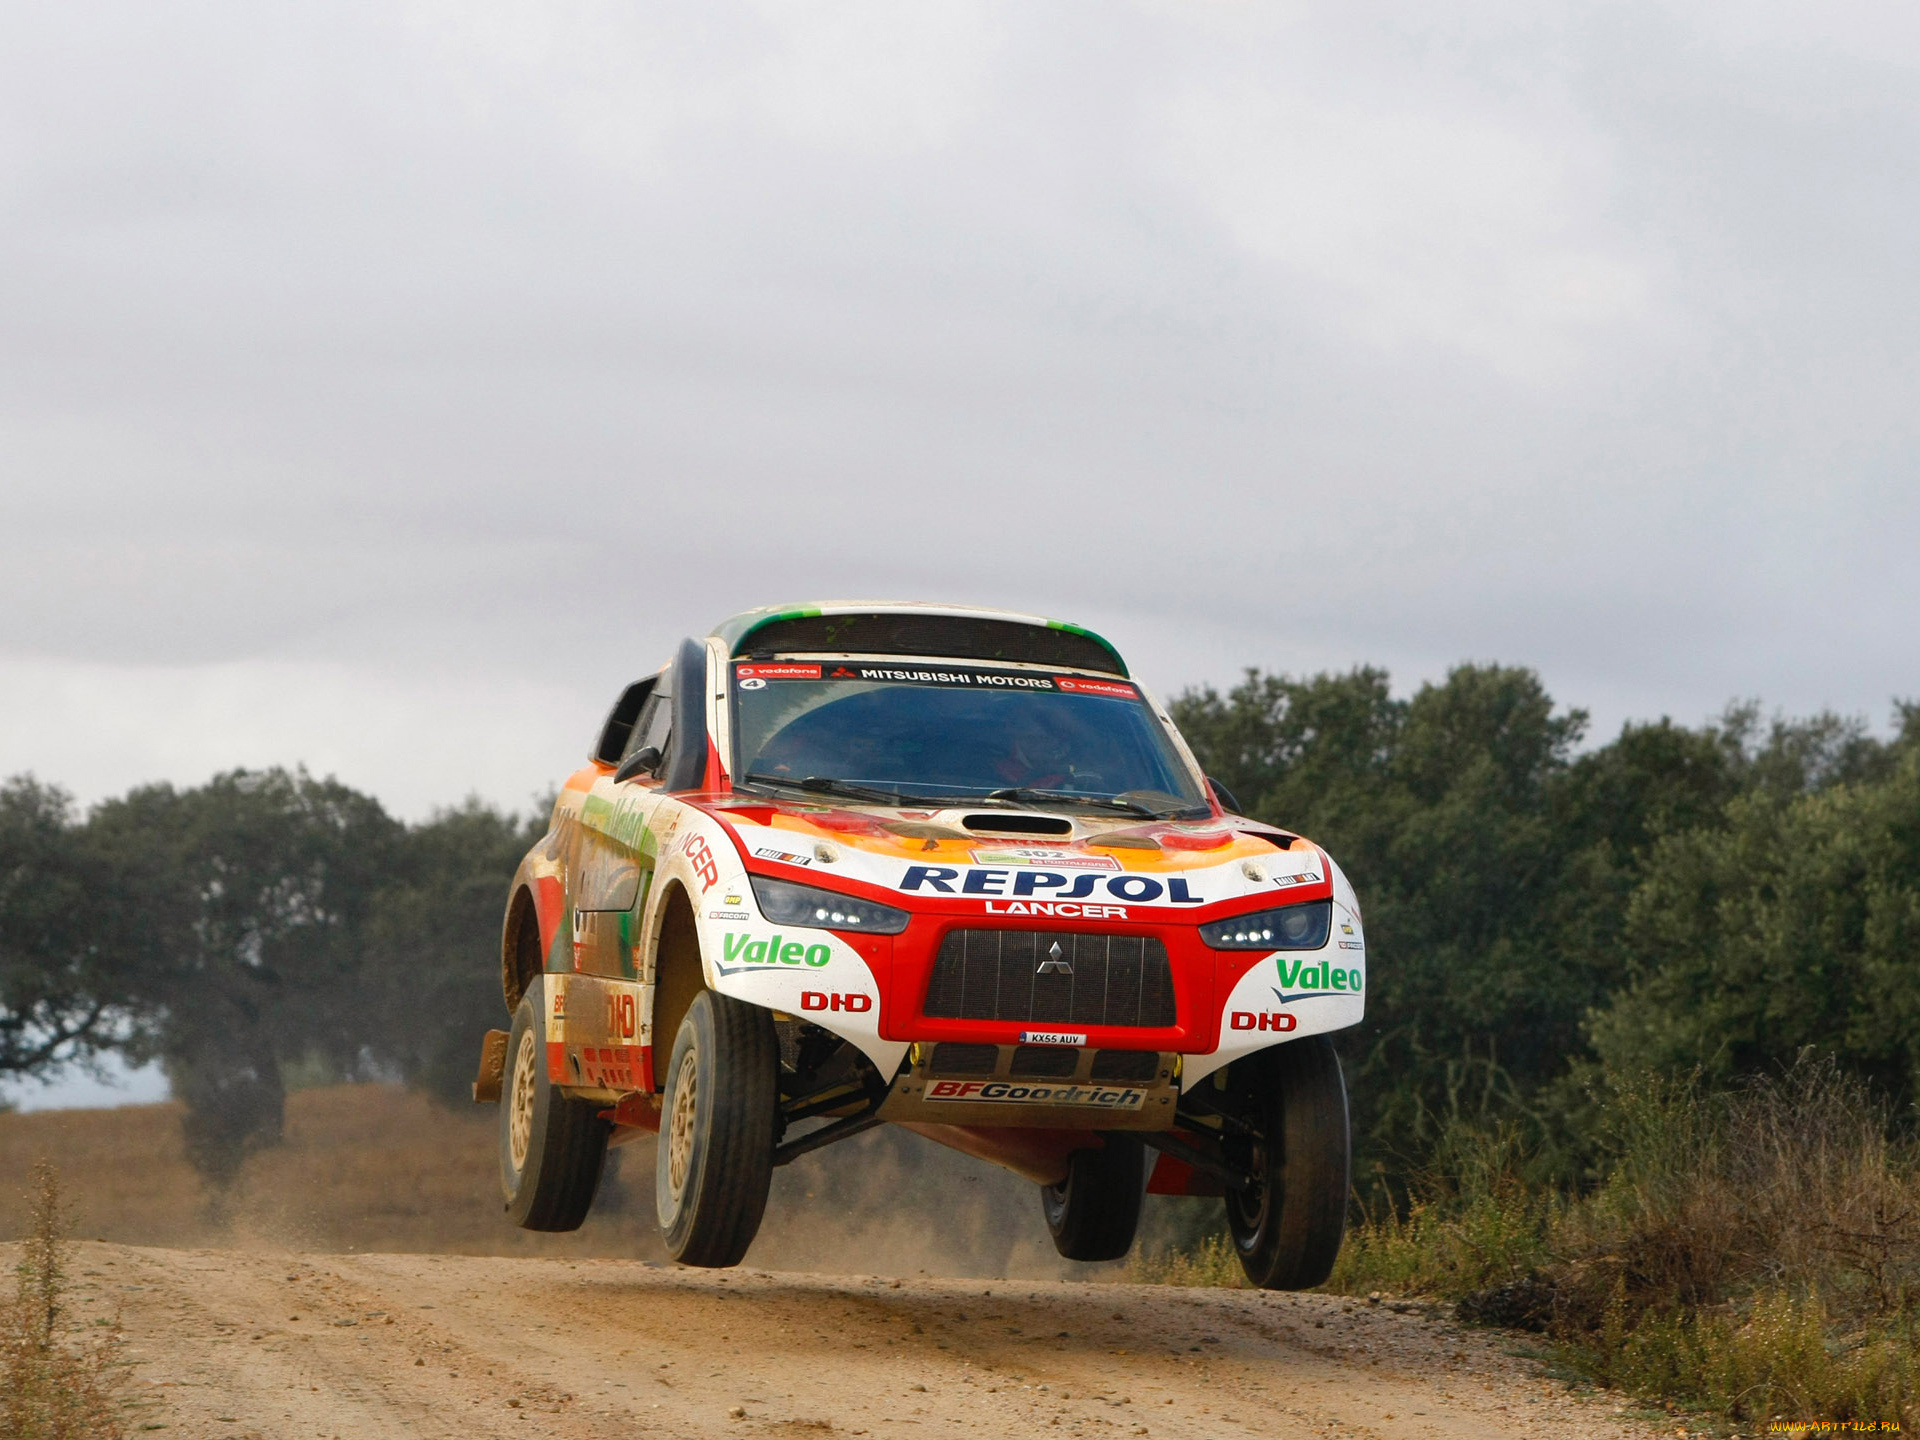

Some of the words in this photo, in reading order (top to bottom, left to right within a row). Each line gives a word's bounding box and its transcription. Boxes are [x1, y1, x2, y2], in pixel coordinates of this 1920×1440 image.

[758, 667, 818, 675] vodafone
[860, 669, 971, 684] MITSUBISHI
[976, 675, 1053, 689] MOTORS
[745, 680, 759, 688] 4
[1078, 683, 1134, 696] vodafone
[1017, 849, 1066, 859] 302
[899, 865, 1205, 903] REPSOL
[984, 900, 1128, 919] LANCER
[723, 932, 831, 967] Valeo
[1276, 958, 1363, 992] Valeo
[1031, 1034, 1057, 1044] KX55
[1059, 1035, 1079, 1044] AUV
[930, 1081, 1142, 1104] BFGoodrich
